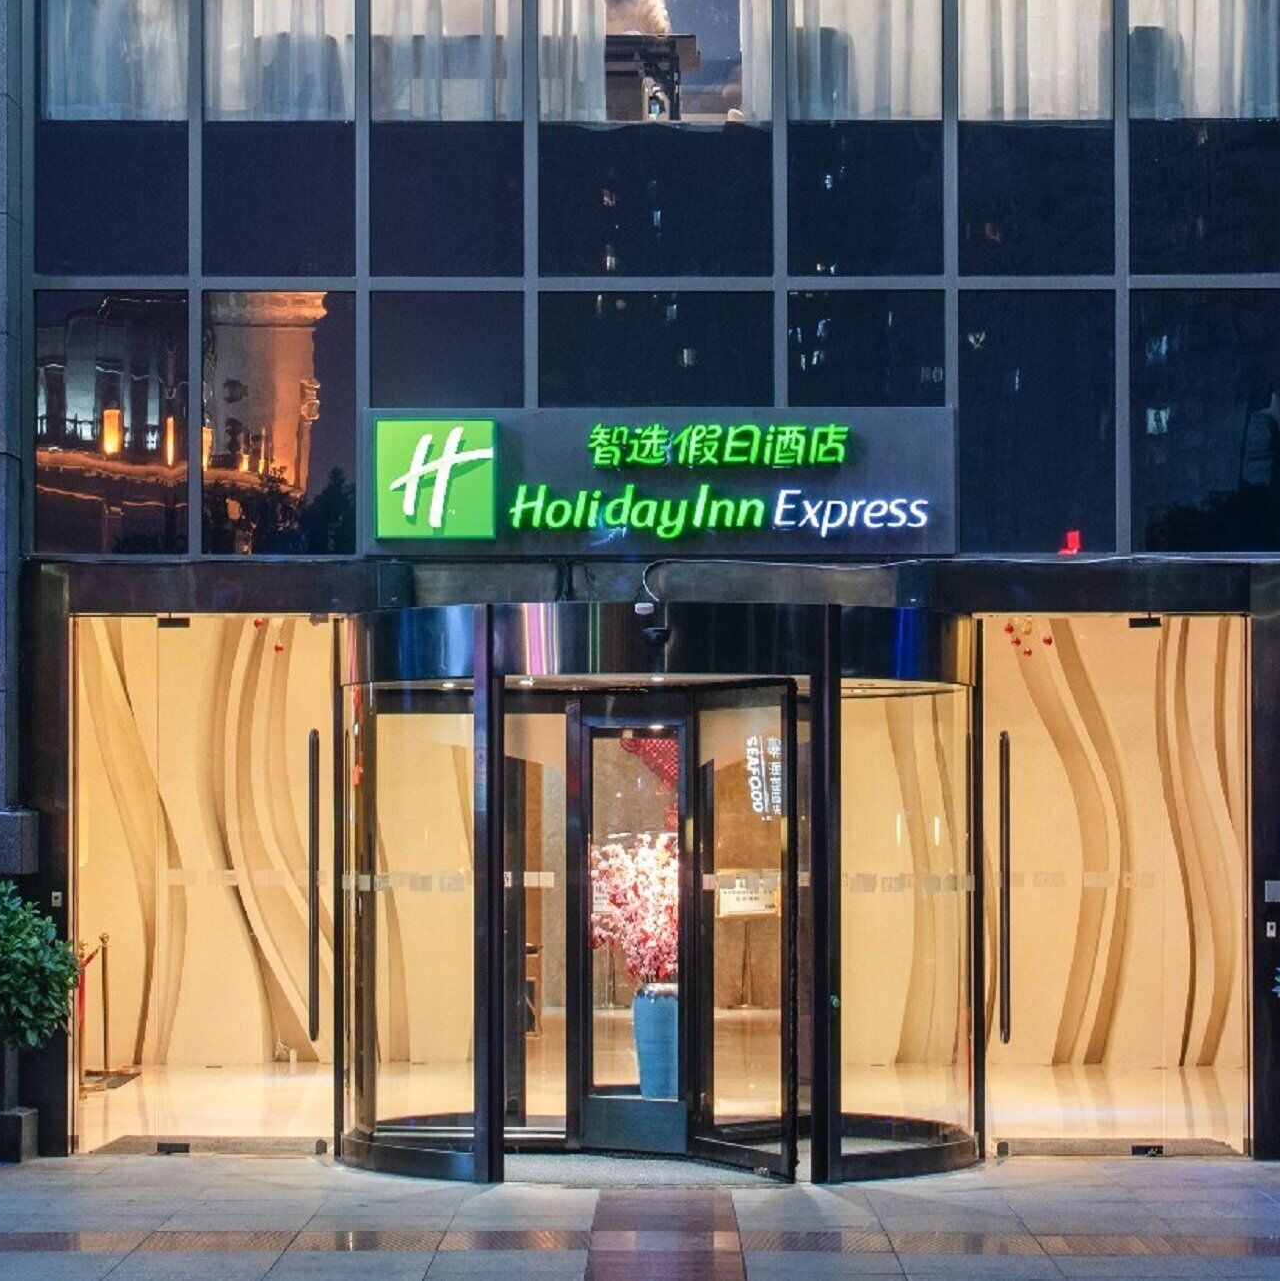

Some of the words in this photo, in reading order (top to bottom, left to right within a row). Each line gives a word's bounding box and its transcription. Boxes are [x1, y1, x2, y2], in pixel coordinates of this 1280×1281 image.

[587, 423, 849, 466] 智选假日酒店
[773, 488, 929, 538] Express
[746, 735, 764, 813] SEAFOOD
